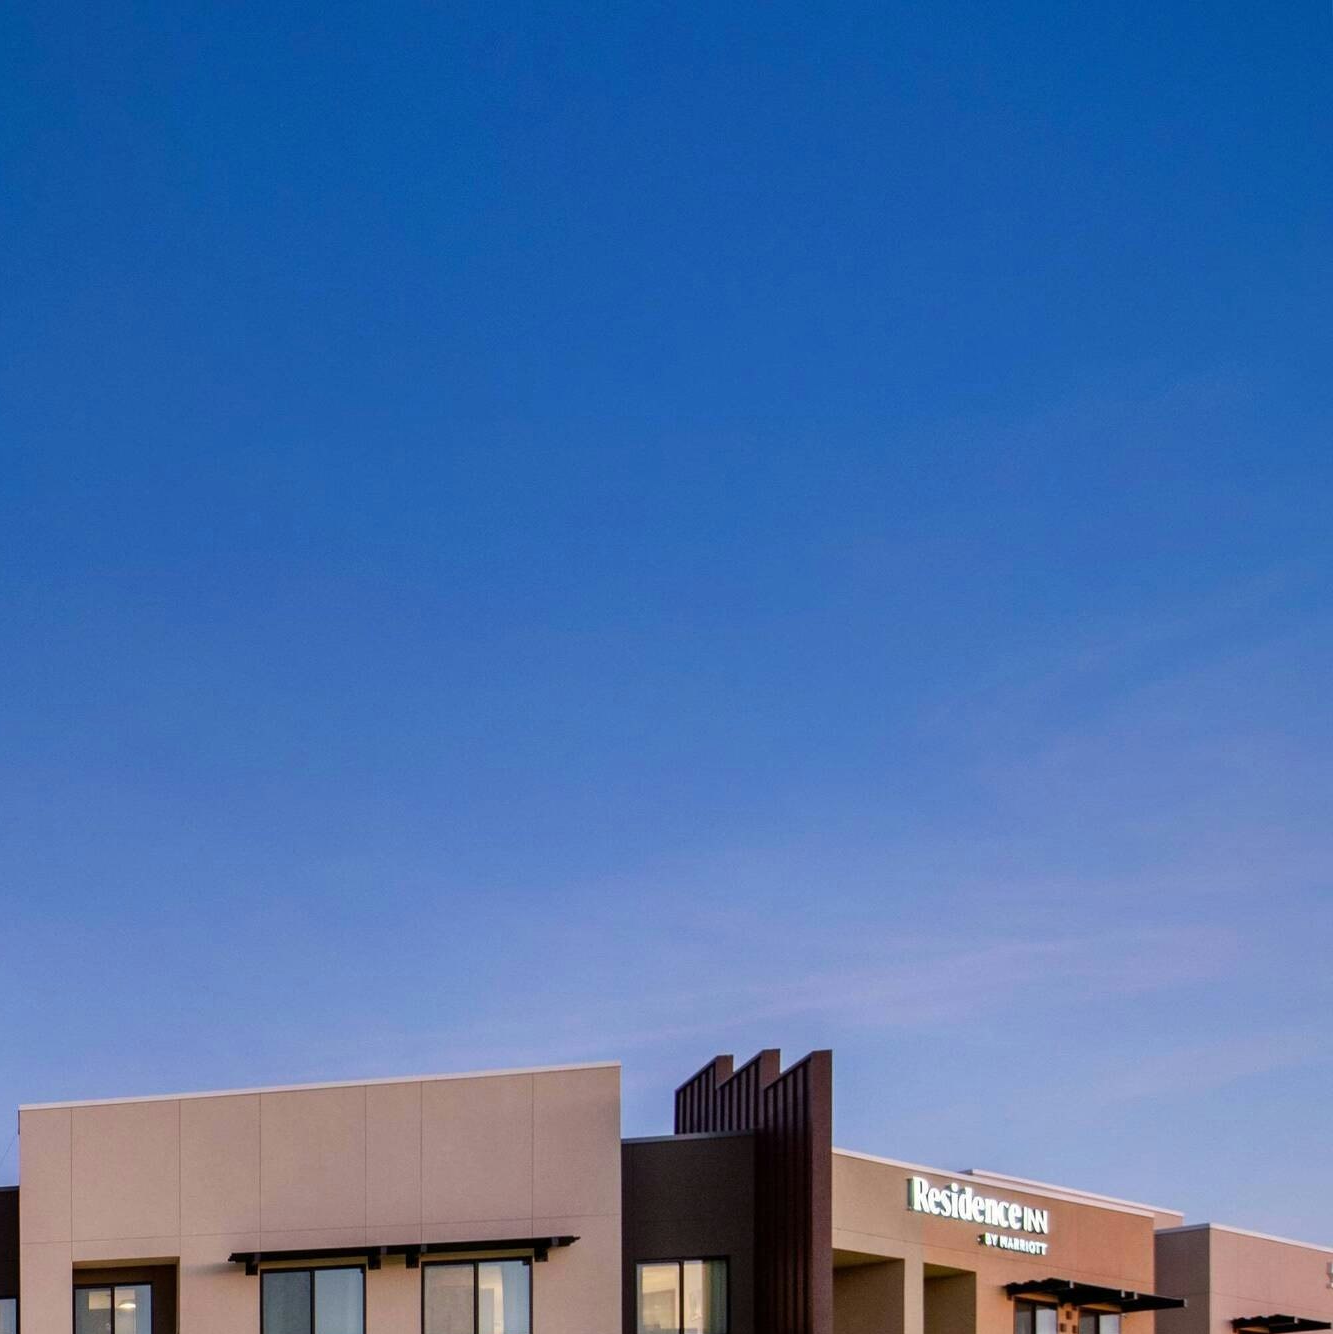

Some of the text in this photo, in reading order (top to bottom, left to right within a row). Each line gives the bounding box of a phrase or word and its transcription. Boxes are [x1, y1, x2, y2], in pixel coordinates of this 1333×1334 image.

[912, 1176, 1048, 1234] Residence INN
[985, 1232, 1048, 1255] BY MARRIOTT
